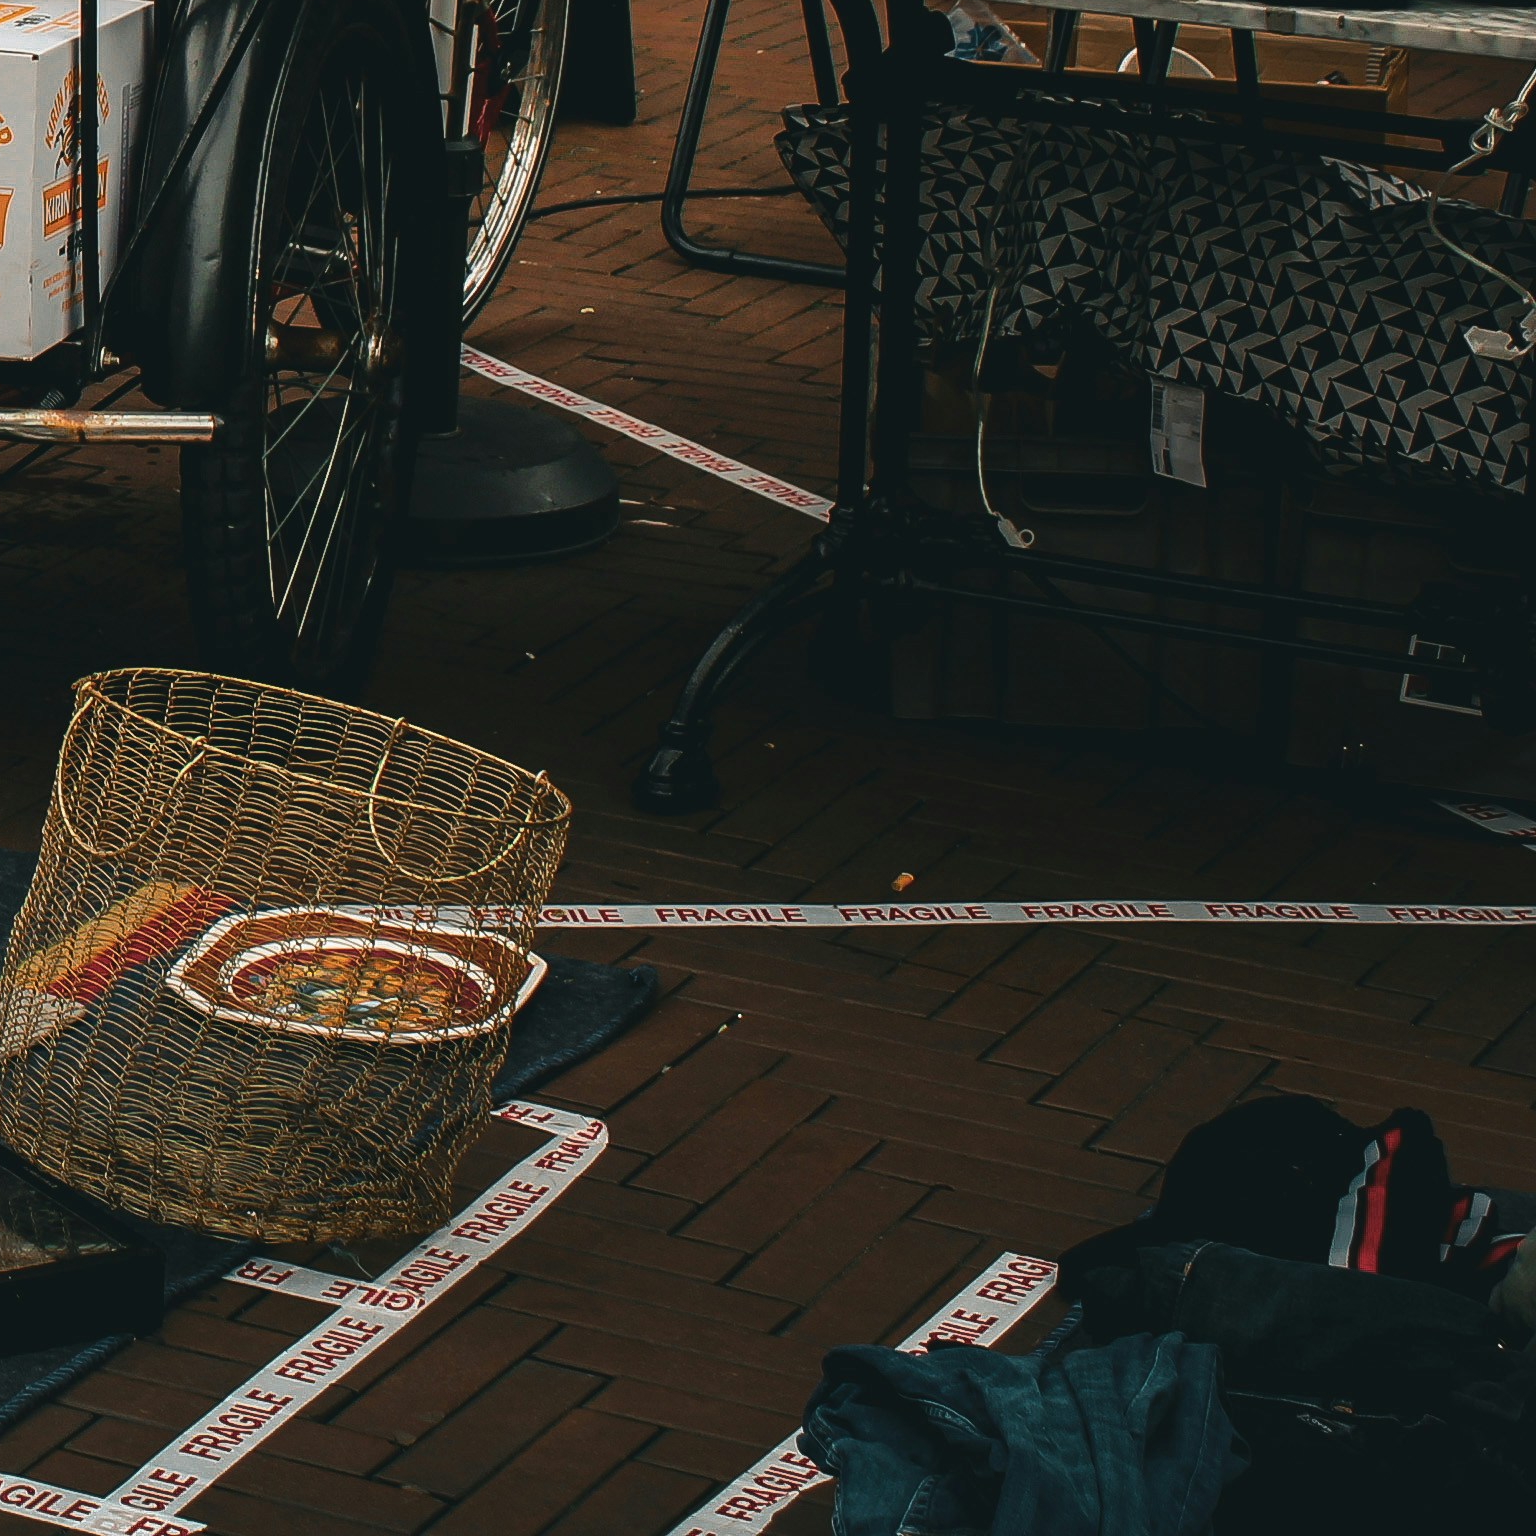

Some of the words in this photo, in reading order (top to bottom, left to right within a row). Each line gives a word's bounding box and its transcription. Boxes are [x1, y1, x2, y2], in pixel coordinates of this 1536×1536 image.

[45, 195, 70, 226] KIRIN
[660, 441, 743, 473] FRAGILE
[739, 475, 827, 507] FRAGILE
[654, 907, 809, 924] FRAGILE
[837, 905, 993, 923] FRAGILE
[1020, 903, 1176, 920] FRAGILE
[1204, 903, 1359, 920] FRAGILE
[179, 1388, 294, 1461] FRAGILE
[274, 1316, 385, 1384] FRAGILE
[450, 1179, 550, 1244] FRAGILE
